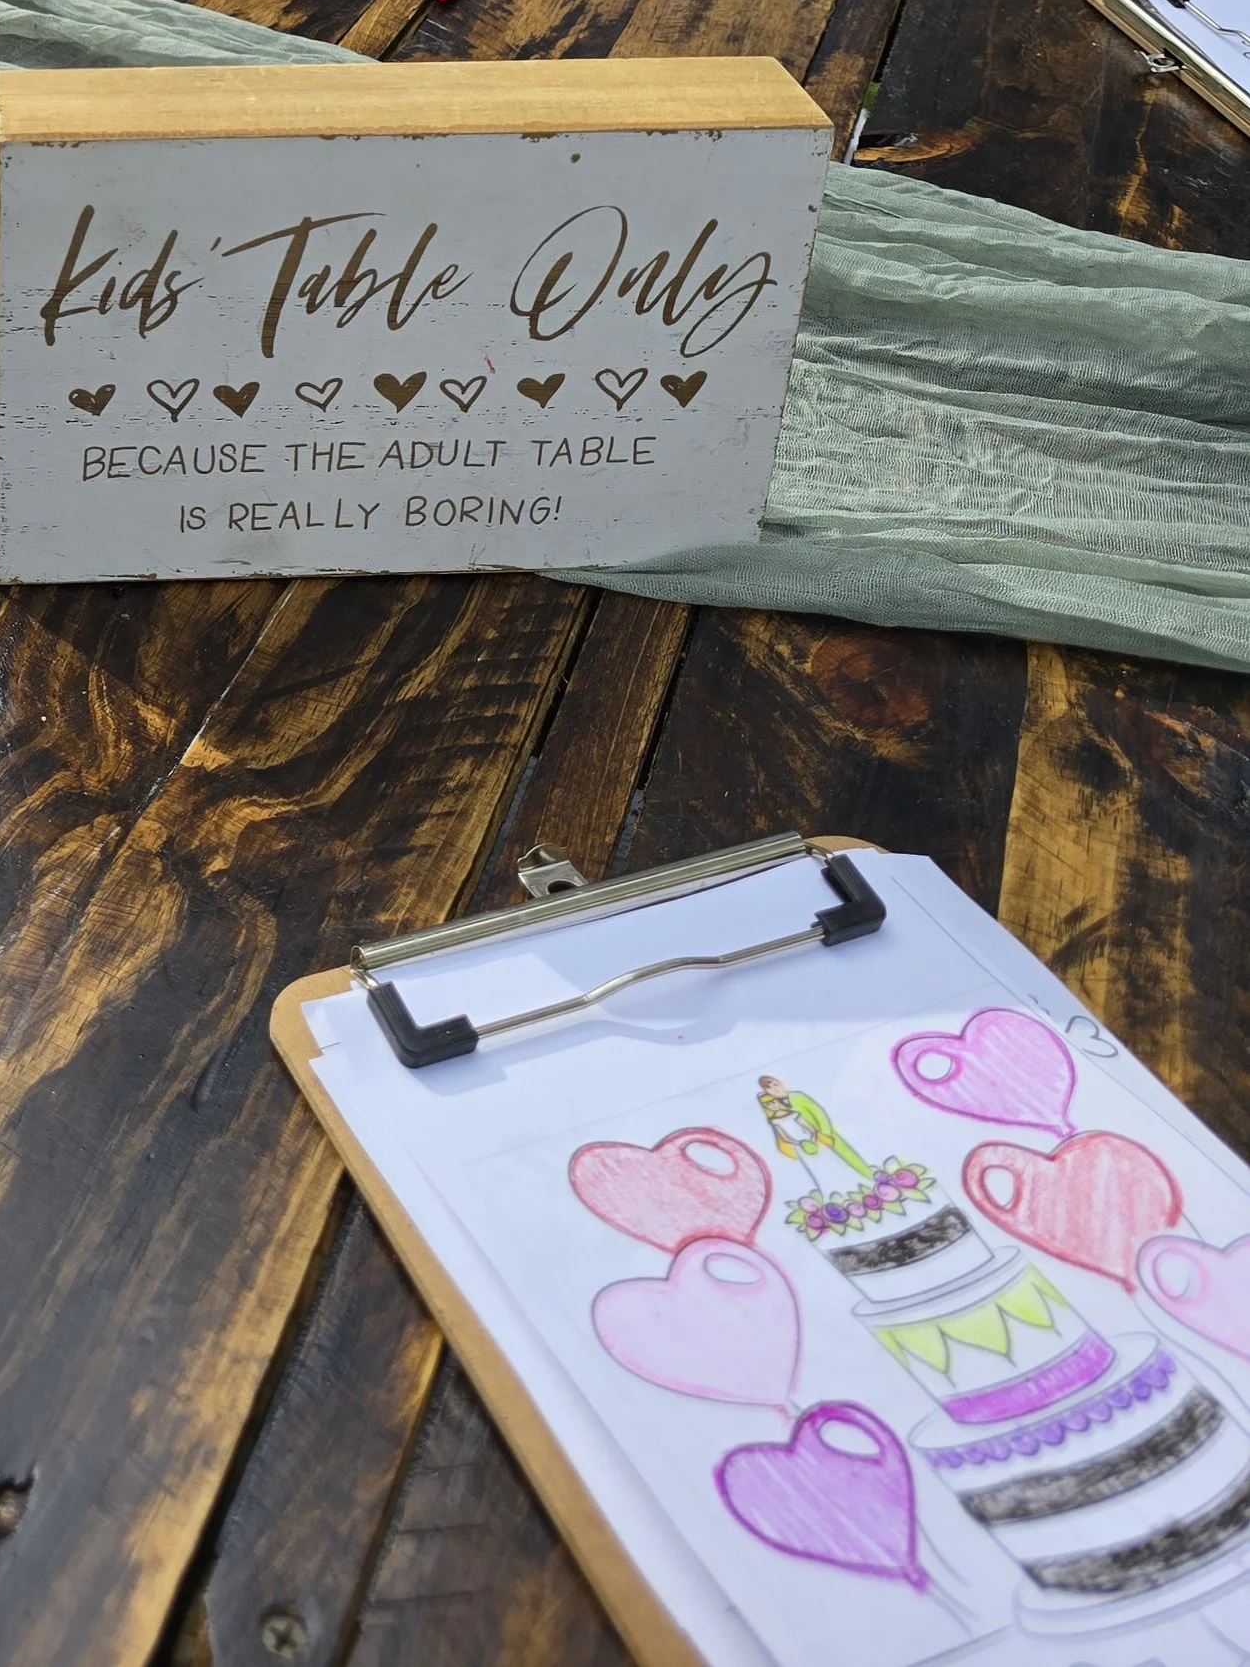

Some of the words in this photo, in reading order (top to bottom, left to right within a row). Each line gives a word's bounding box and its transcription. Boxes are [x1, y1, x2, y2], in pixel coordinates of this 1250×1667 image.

[40, 204, 222, 346] Kids'
[221, 212, 474, 358] Table
[509, 205, 778, 358] Only
[82, 443, 268, 481] BECAUSE
[285, 442, 366, 472] THE
[378, 438, 507, 470] ADULT
[531, 436, 656, 467] TABLE
[180, 505, 206, 533] IS
[228, 498, 380, 532] REALLY
[405, 495, 562, 526] BORING!
